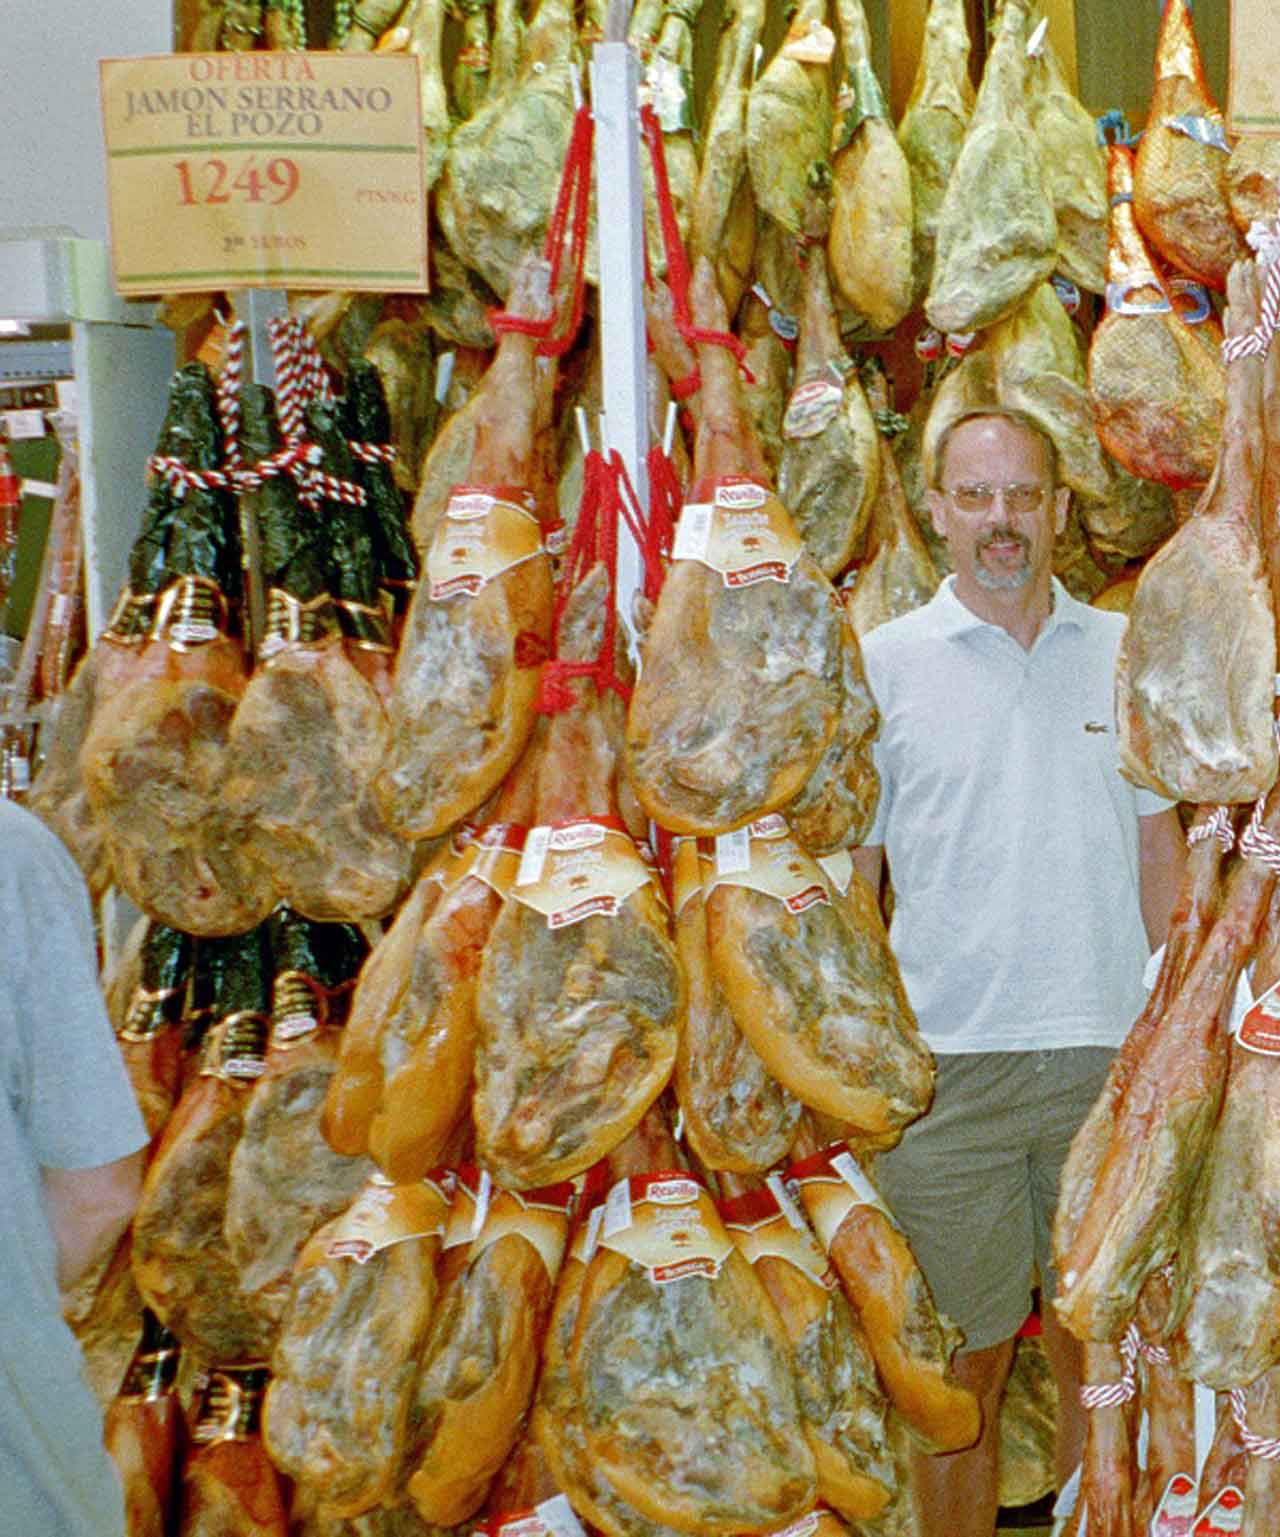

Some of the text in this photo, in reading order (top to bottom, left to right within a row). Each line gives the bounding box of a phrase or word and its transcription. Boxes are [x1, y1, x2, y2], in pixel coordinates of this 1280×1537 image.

[190, 55, 316, 82] OFERTA
[237, 86, 393, 113] SERRANO
[186, 111, 324, 138] EL POZO
[174, 156, 301, 206] 1249
